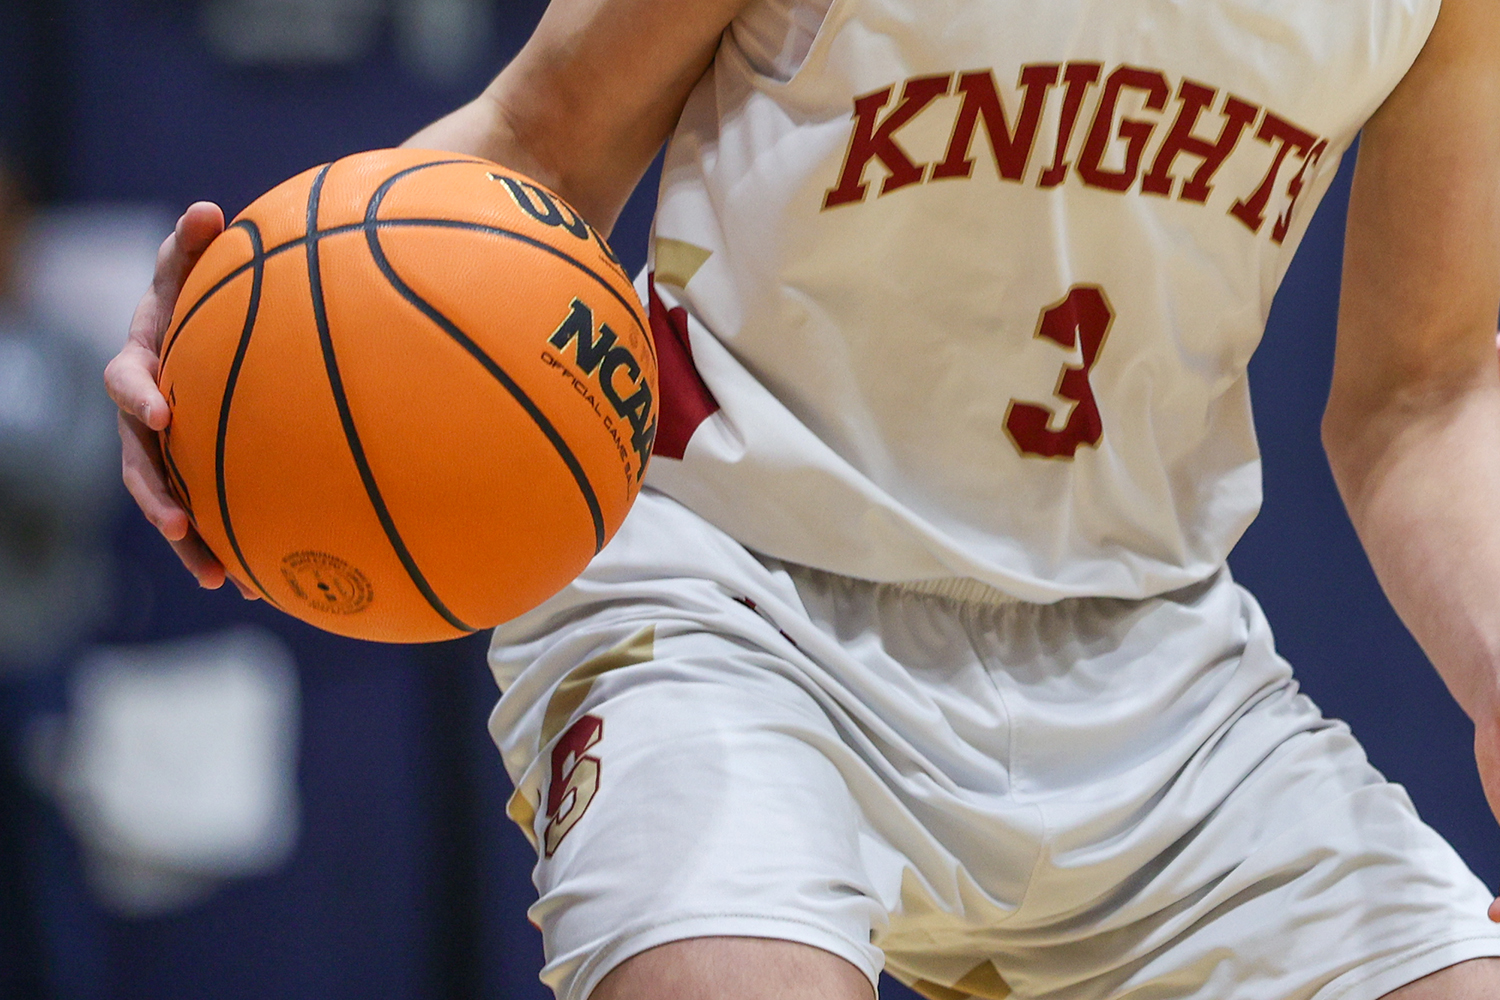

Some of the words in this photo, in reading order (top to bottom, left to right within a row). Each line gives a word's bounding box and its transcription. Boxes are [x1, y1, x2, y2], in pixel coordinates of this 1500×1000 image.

[540, 350, 602, 418] OFFICIAL
[603, 414, 629, 463] GAME
[1001, 281, 1116, 461] 3
